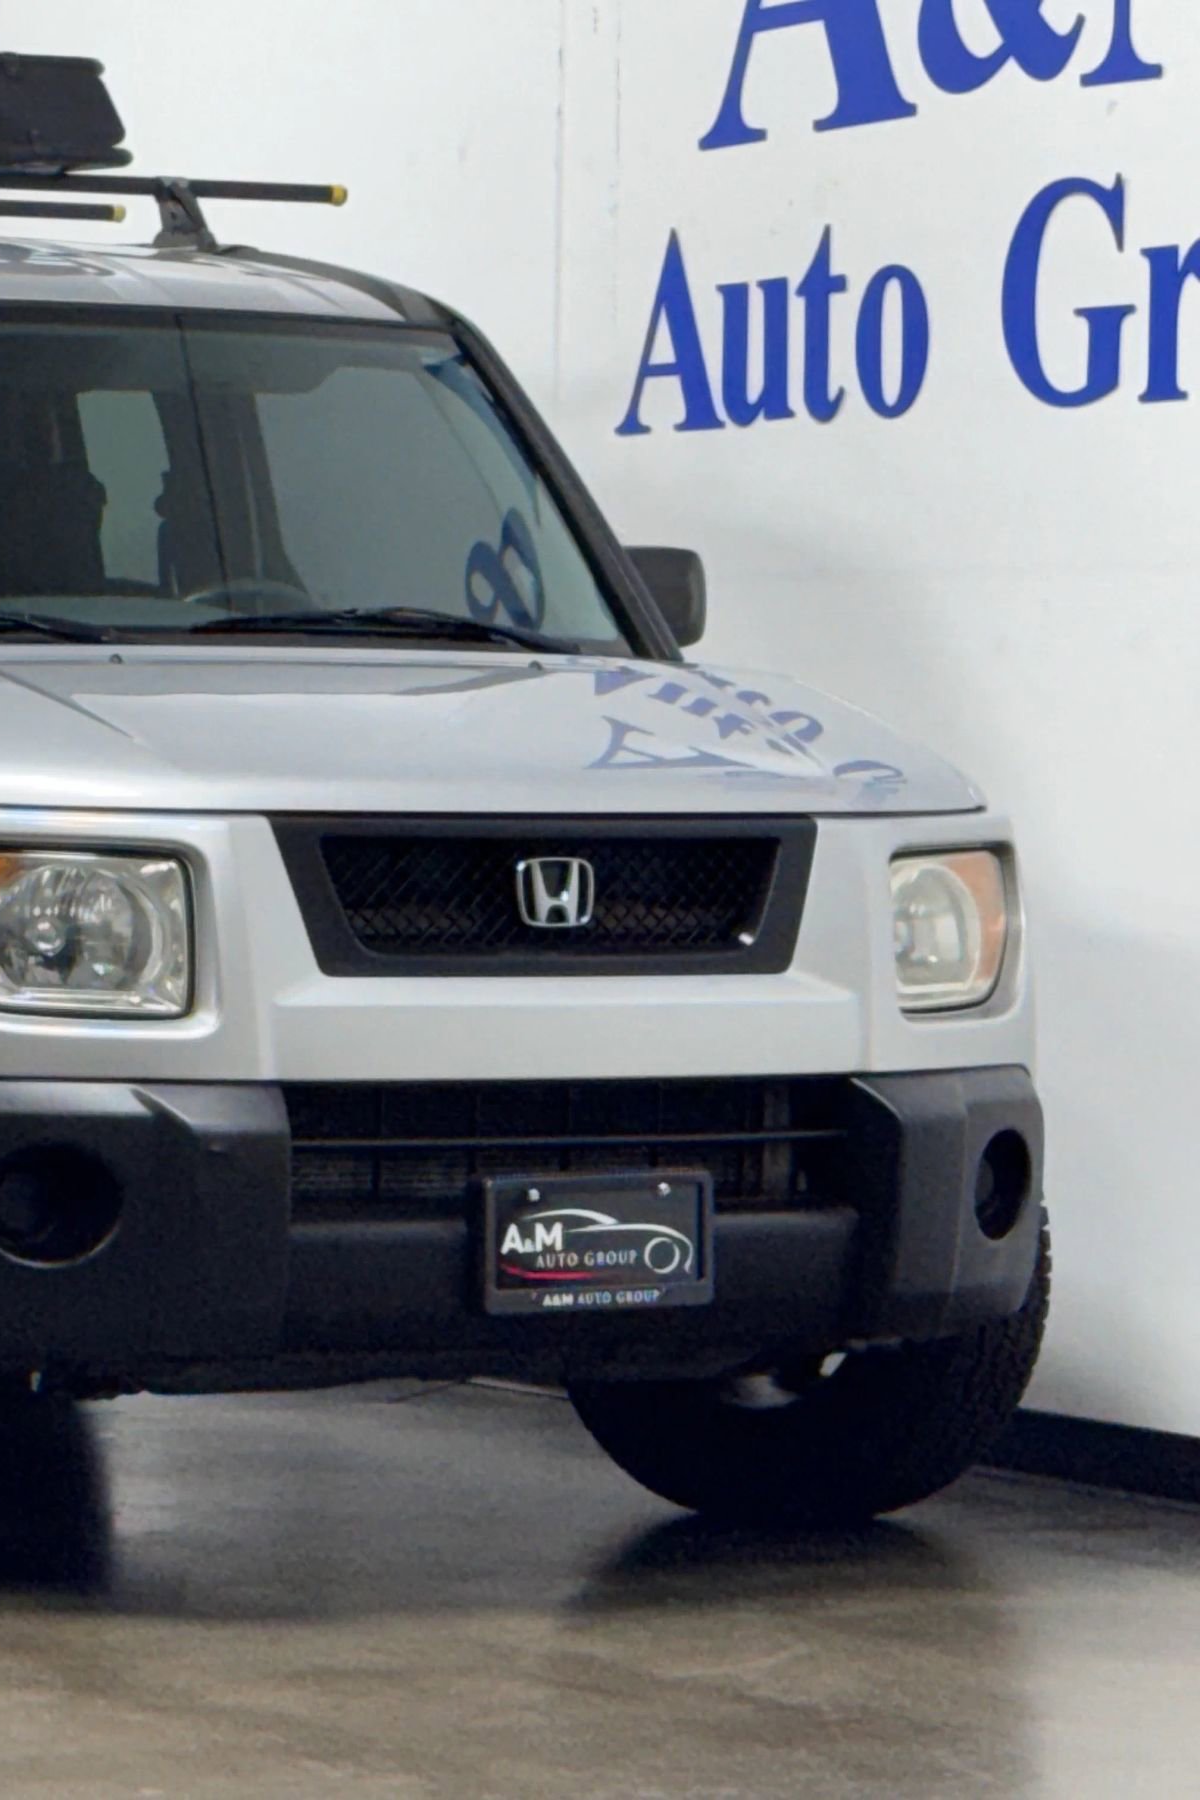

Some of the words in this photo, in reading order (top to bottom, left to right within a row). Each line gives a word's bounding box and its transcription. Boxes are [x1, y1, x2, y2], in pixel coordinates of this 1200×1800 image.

[614, 223, 929, 436] Auto
[500, 1221, 563, 1255] A&M
[535, 1251, 580, 1268] AUTO
[584, 1249, 637, 1266] GROUP
[577, 1291, 612, 1305] AUTO
[616, 1289, 660, 1304] GROUP
